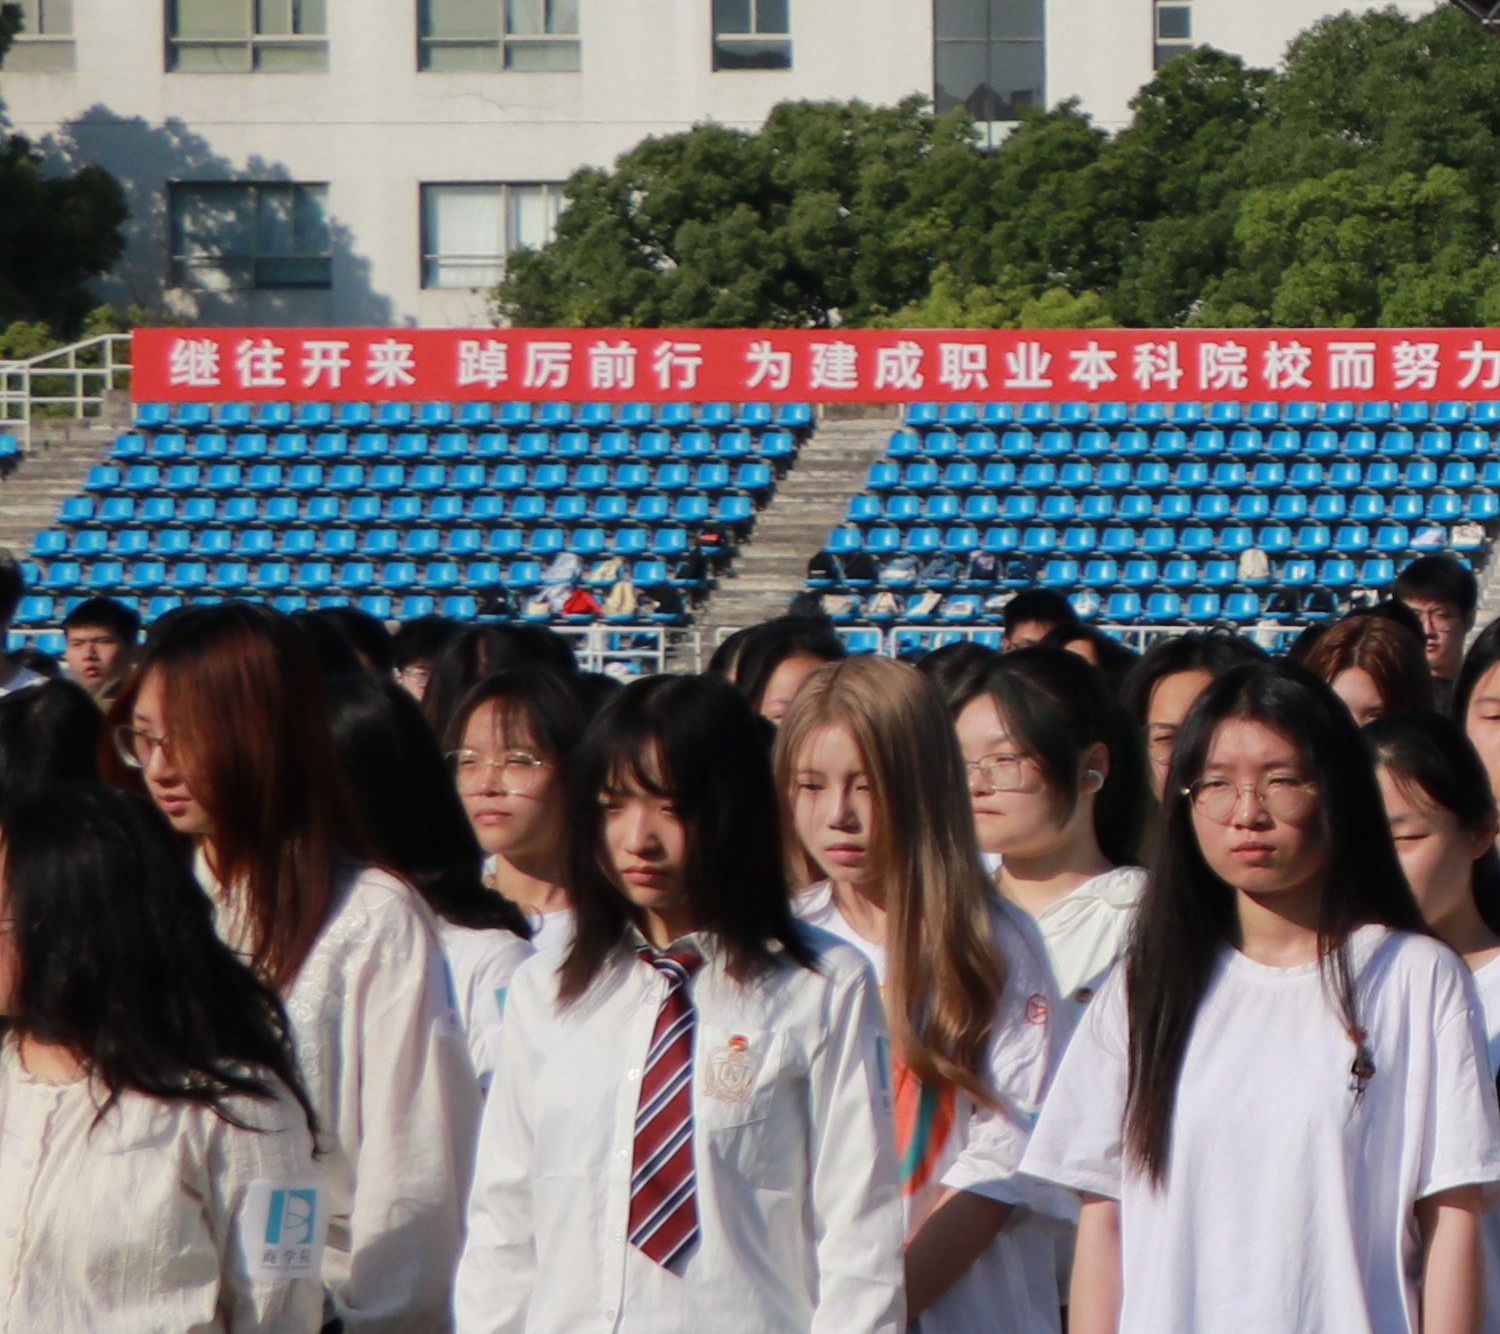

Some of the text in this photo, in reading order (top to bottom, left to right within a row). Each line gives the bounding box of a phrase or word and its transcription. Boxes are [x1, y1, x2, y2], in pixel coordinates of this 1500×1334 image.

[169, 339, 416, 388] 继往开来
[457, 340, 703, 389] 踔厉前行
